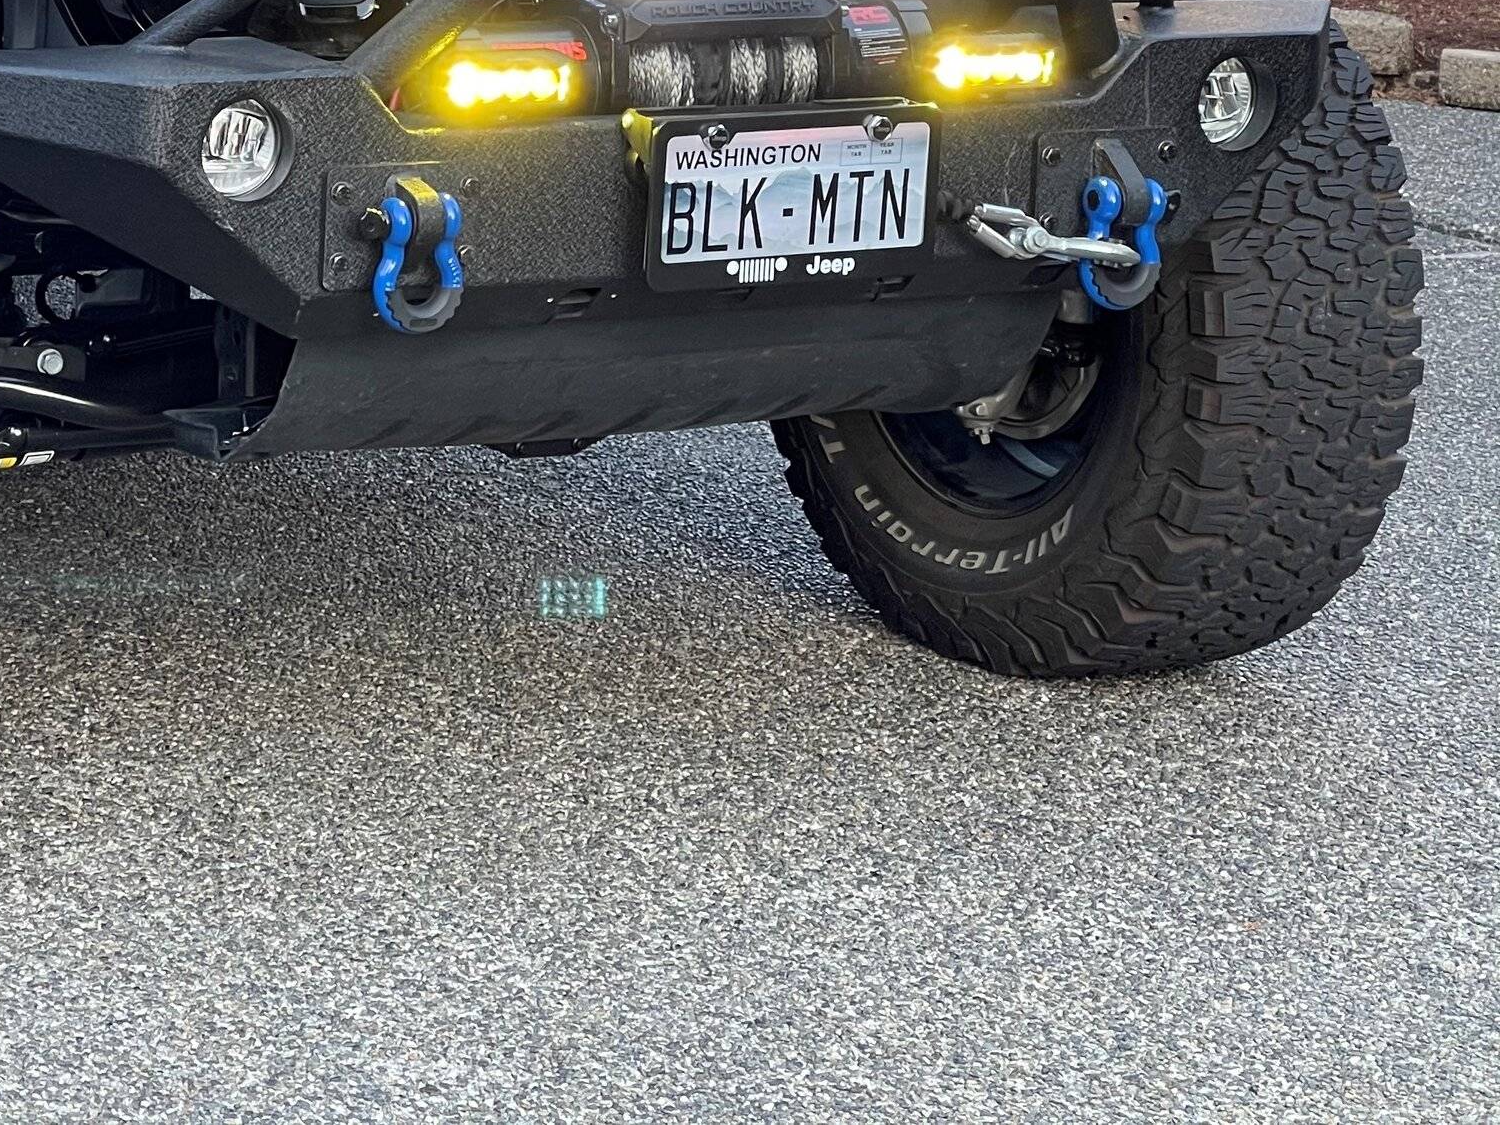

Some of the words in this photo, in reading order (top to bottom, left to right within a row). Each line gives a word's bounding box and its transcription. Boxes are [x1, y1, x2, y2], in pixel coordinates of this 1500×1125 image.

[651, 5, 718, 18] ROUGH
[723, 0, 816, 15] COUNTRY
[675, 143, 821, 170] WASHINGTON
[806, 256, 856, 276] Jeep
[853, 484, 1074, 574] All-Terrain
